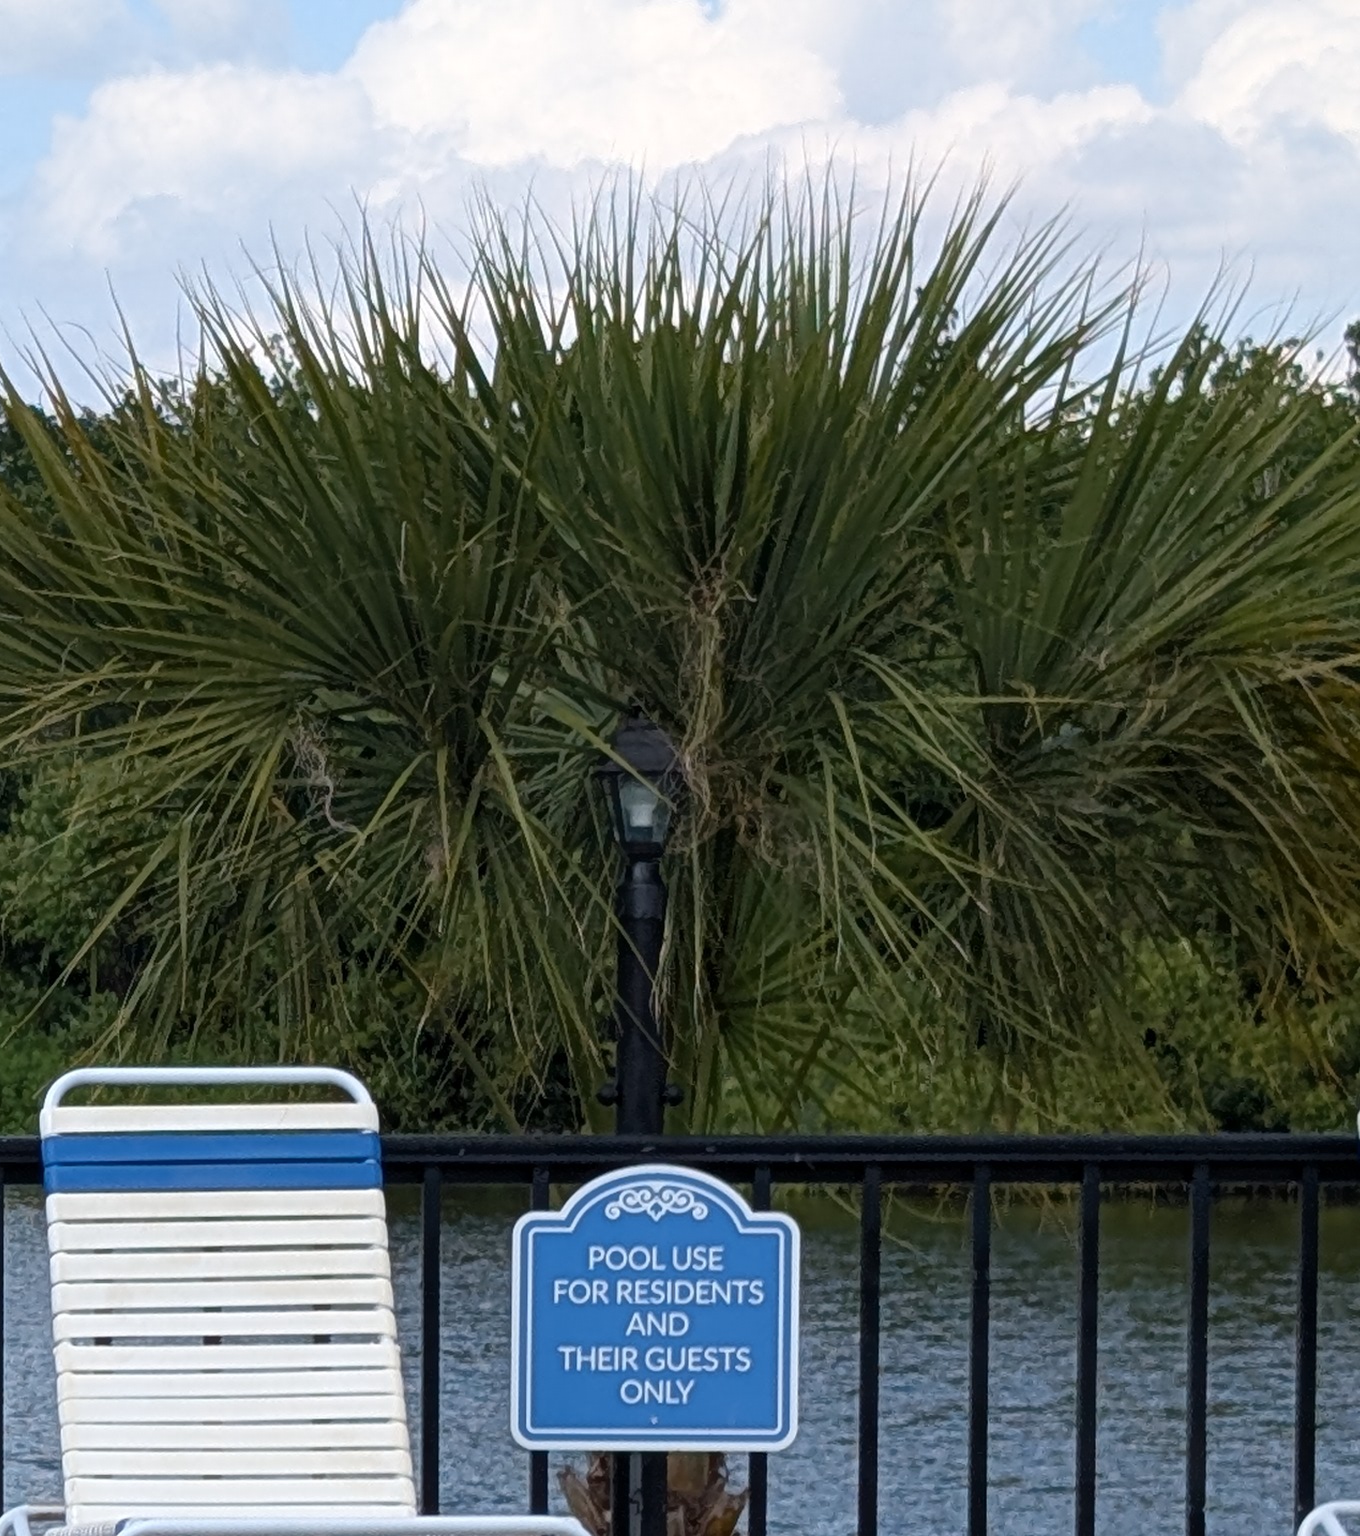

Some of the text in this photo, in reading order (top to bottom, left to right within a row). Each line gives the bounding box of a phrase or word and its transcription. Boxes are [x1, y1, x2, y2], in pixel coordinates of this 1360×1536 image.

[588, 1246, 724, 1272] POOL USE
[553, 1280, 765, 1305] FOR RESIDENTS
[625, 1312, 690, 1337] AND
[557, 1346, 752, 1372] THEIR GUESTS
[620, 1379, 695, 1405] ONLY
